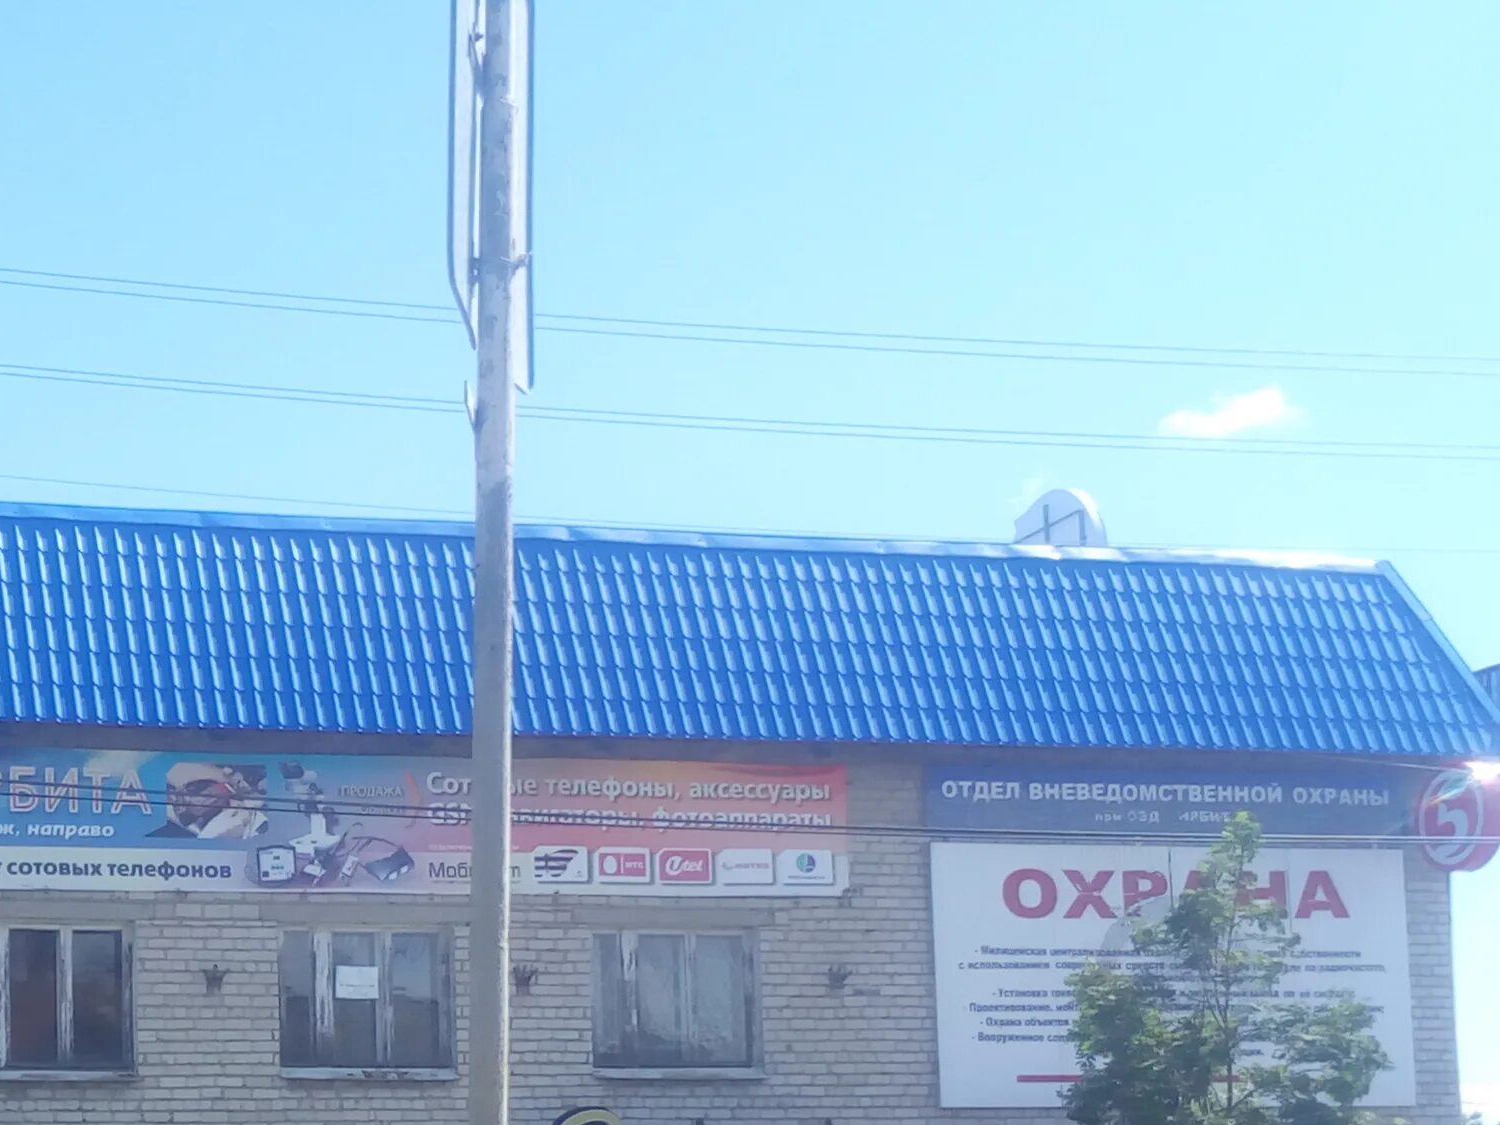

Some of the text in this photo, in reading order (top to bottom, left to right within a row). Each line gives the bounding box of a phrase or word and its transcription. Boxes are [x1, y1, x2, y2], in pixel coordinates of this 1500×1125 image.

[340, 784, 404, 797] ПРОДАЖА
[427, 771, 831, 804] Сотые телефоны, аксессуары
[942, 780, 1389, 806] ОТДЕЛ ВНЕВЕДОМСТВЕННОЙ ОХРАНЫ
[509, 806, 645, 830] авигаторы,
[27, 822, 114, 839] направо
[7, 861, 102, 877] сотовых
[107, 858, 232, 881] телефонов
[665, 855, 703, 876] Utel
